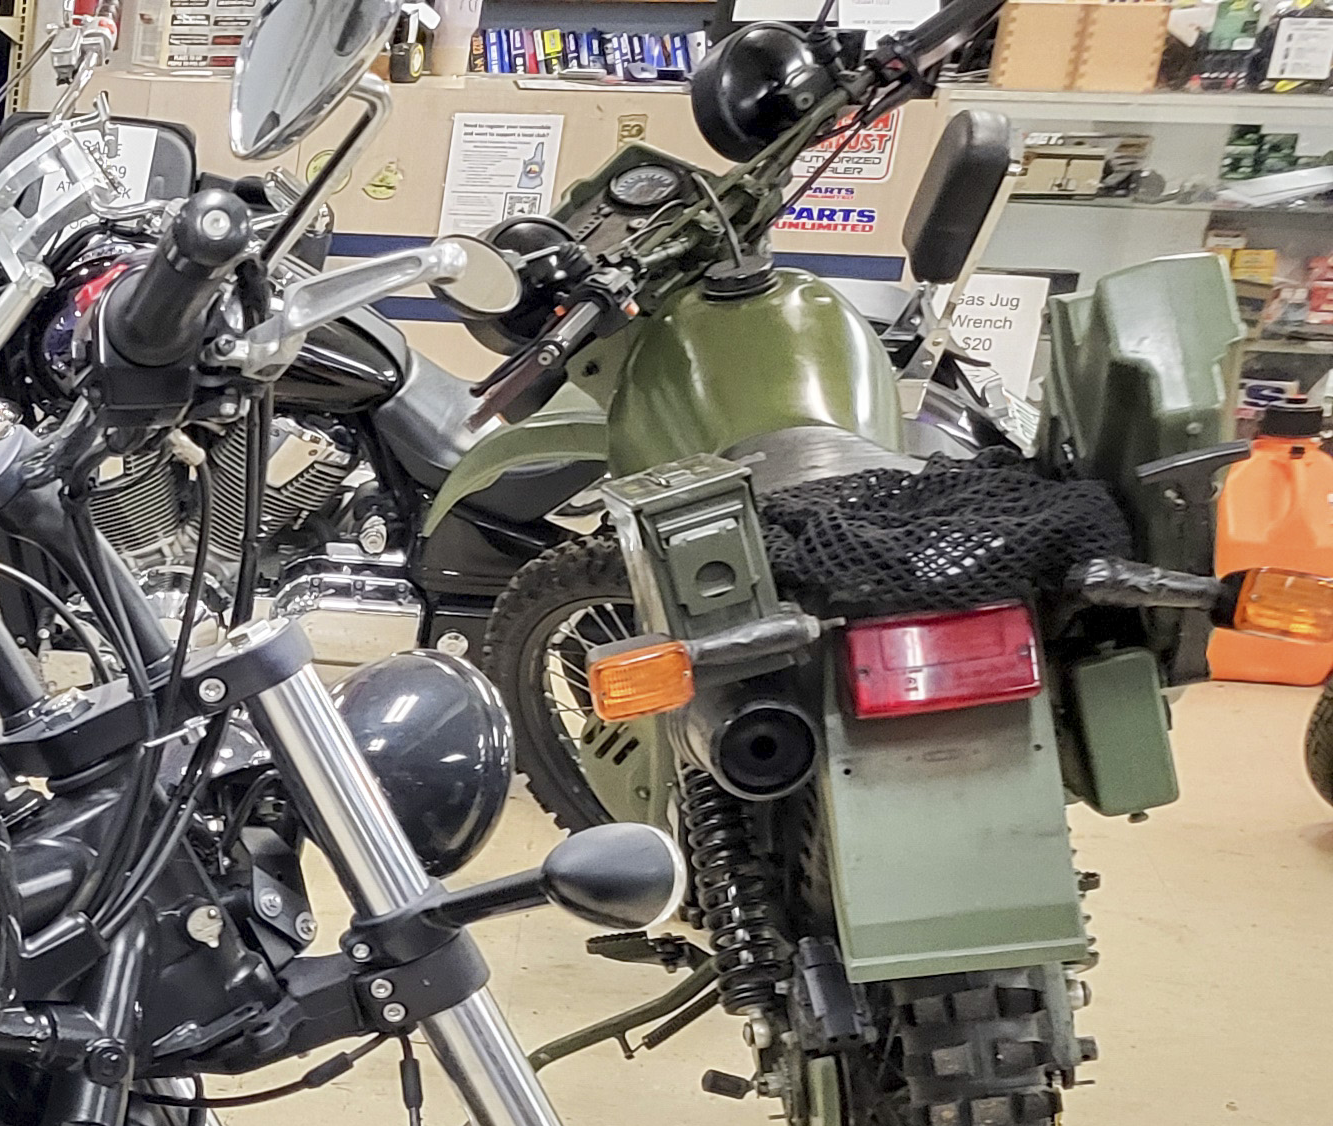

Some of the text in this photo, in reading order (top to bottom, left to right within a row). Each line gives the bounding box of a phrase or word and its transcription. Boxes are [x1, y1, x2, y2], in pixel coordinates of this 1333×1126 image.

[774, 220, 874, 233] UNLIMITED
[990, 293, 1021, 311] Jug
[961, 336, 993, 351] $20
